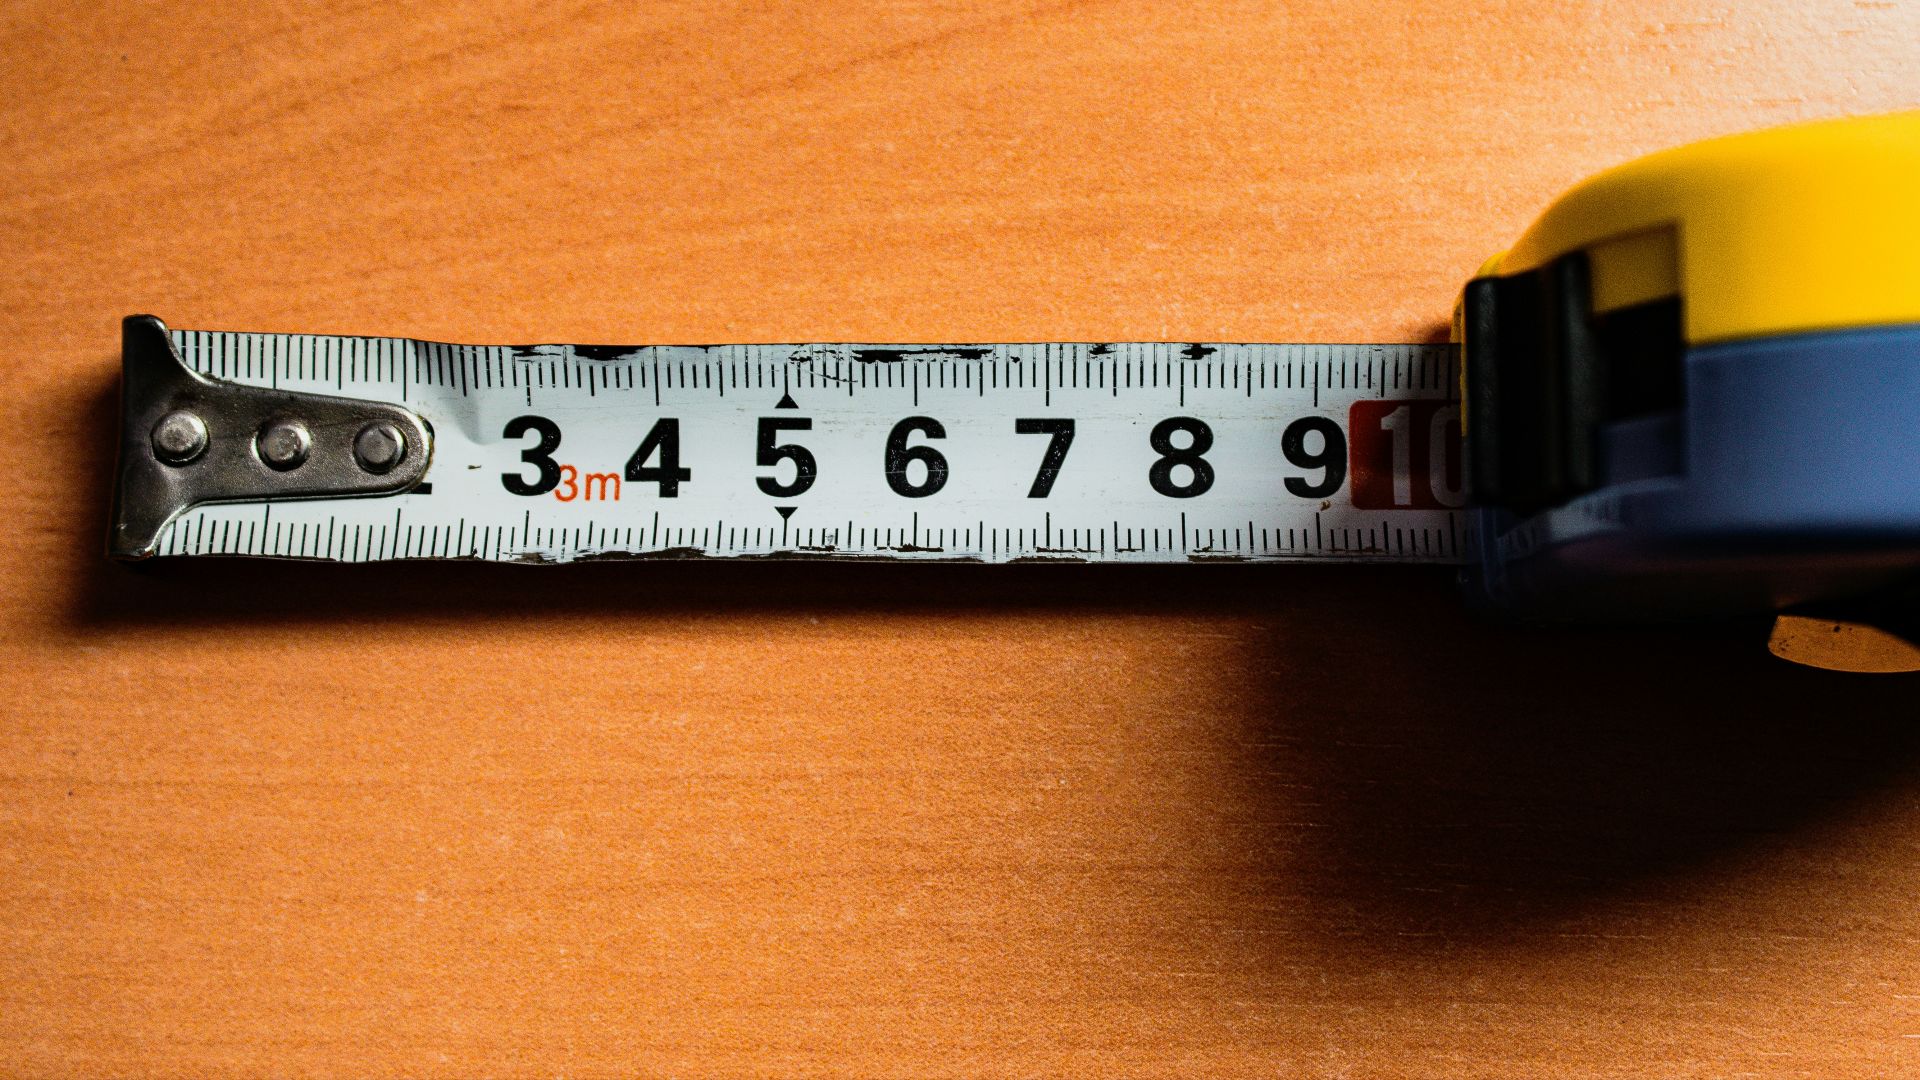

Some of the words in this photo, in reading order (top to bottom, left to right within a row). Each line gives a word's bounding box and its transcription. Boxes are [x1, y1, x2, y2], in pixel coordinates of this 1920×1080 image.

[501, 414, 562, 496] 3
[625, 417, 691, 498] 4
[756, 417, 817, 498] 5
[885, 415, 949, 498] 6
[1015, 418, 1076, 498] 7
[1149, 416, 1215, 498] 8
[1281, 416, 1348, 499] 9
[1380, 404, 1471, 508] 10
[555, 464, 621, 501] 3m
